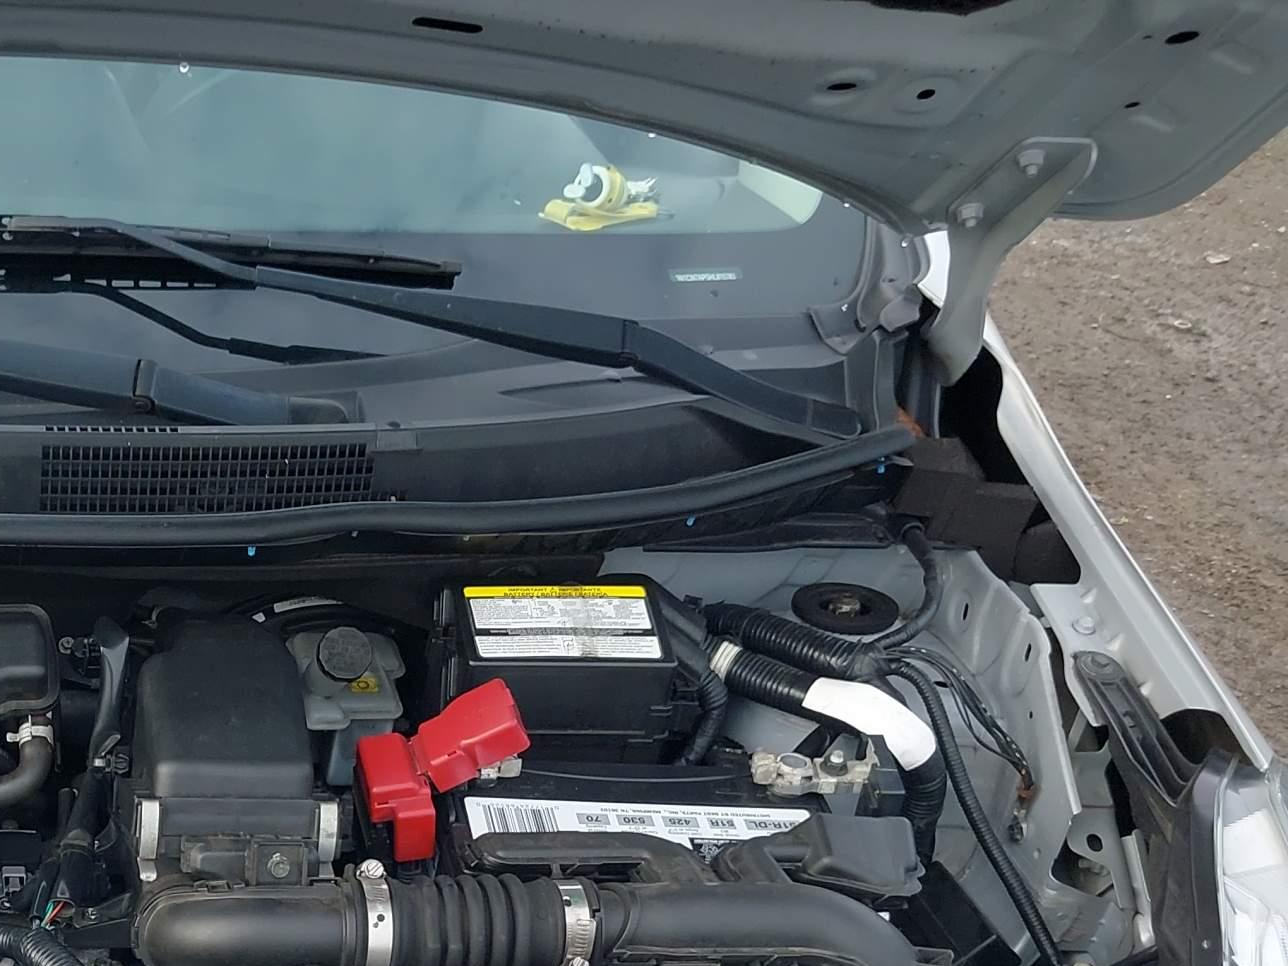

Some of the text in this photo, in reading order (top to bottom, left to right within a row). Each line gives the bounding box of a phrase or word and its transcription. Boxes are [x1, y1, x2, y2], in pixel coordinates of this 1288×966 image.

[585, 815, 602, 823] 70
[623, 816, 646, 825] 530
[668, 818, 691, 826] 425
[710, 819, 735, 828] 51R
